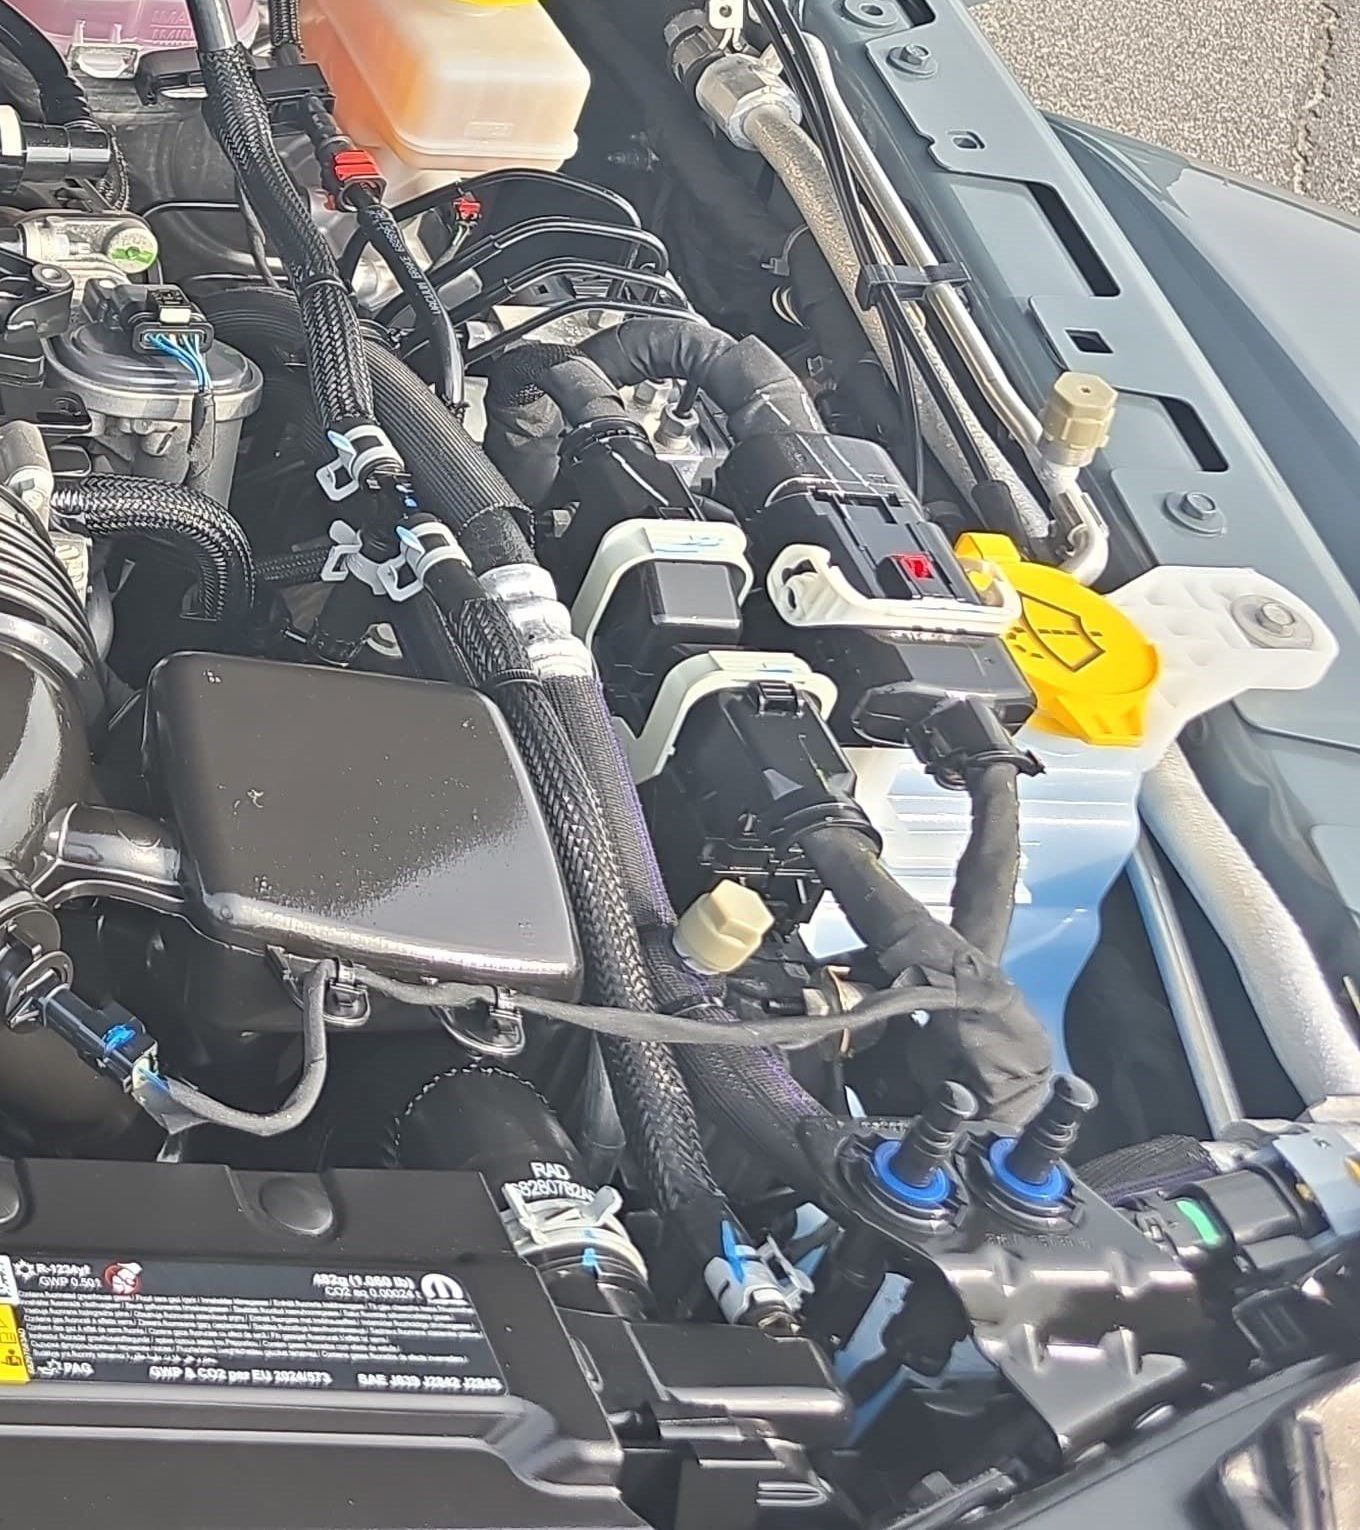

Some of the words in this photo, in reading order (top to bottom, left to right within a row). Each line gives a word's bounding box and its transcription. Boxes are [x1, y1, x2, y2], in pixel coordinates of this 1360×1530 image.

[530, 1162, 571, 1180] RAD
[39, 1276, 69, 1288] GWP
[325, 1286, 351, 1297] CO2
[64, 1362, 94, 1376] PAG
[149, 1366, 182, 1381] GWP
[197, 1367, 227, 1382] CO2
[251, 1368, 272, 1383] EU
[357, 1373, 388, 1387] SAE
